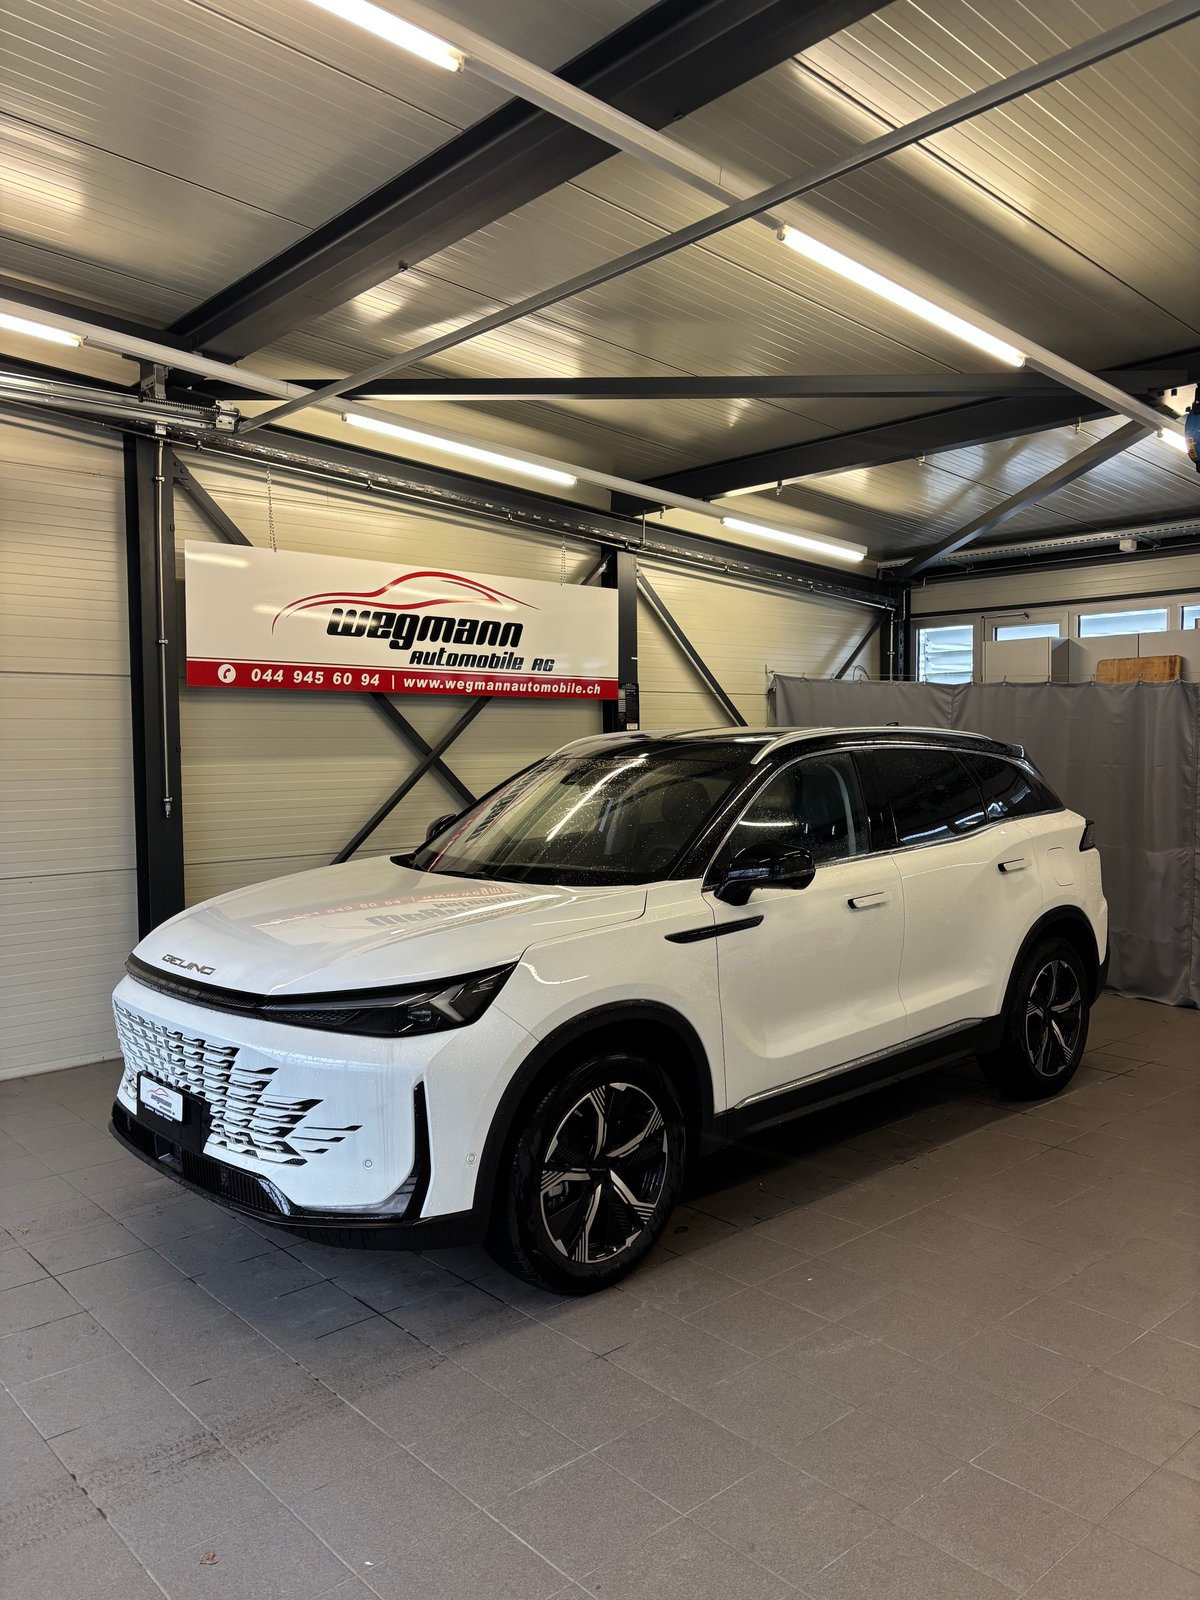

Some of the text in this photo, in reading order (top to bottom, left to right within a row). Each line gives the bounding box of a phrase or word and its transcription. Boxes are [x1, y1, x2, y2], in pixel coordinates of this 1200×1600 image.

[326, 608, 523, 650] wegmann
[531, 658, 555, 672] AG
[251, 668, 601, 694] 044 945 60 94 www.wegmannautomobile.ch
